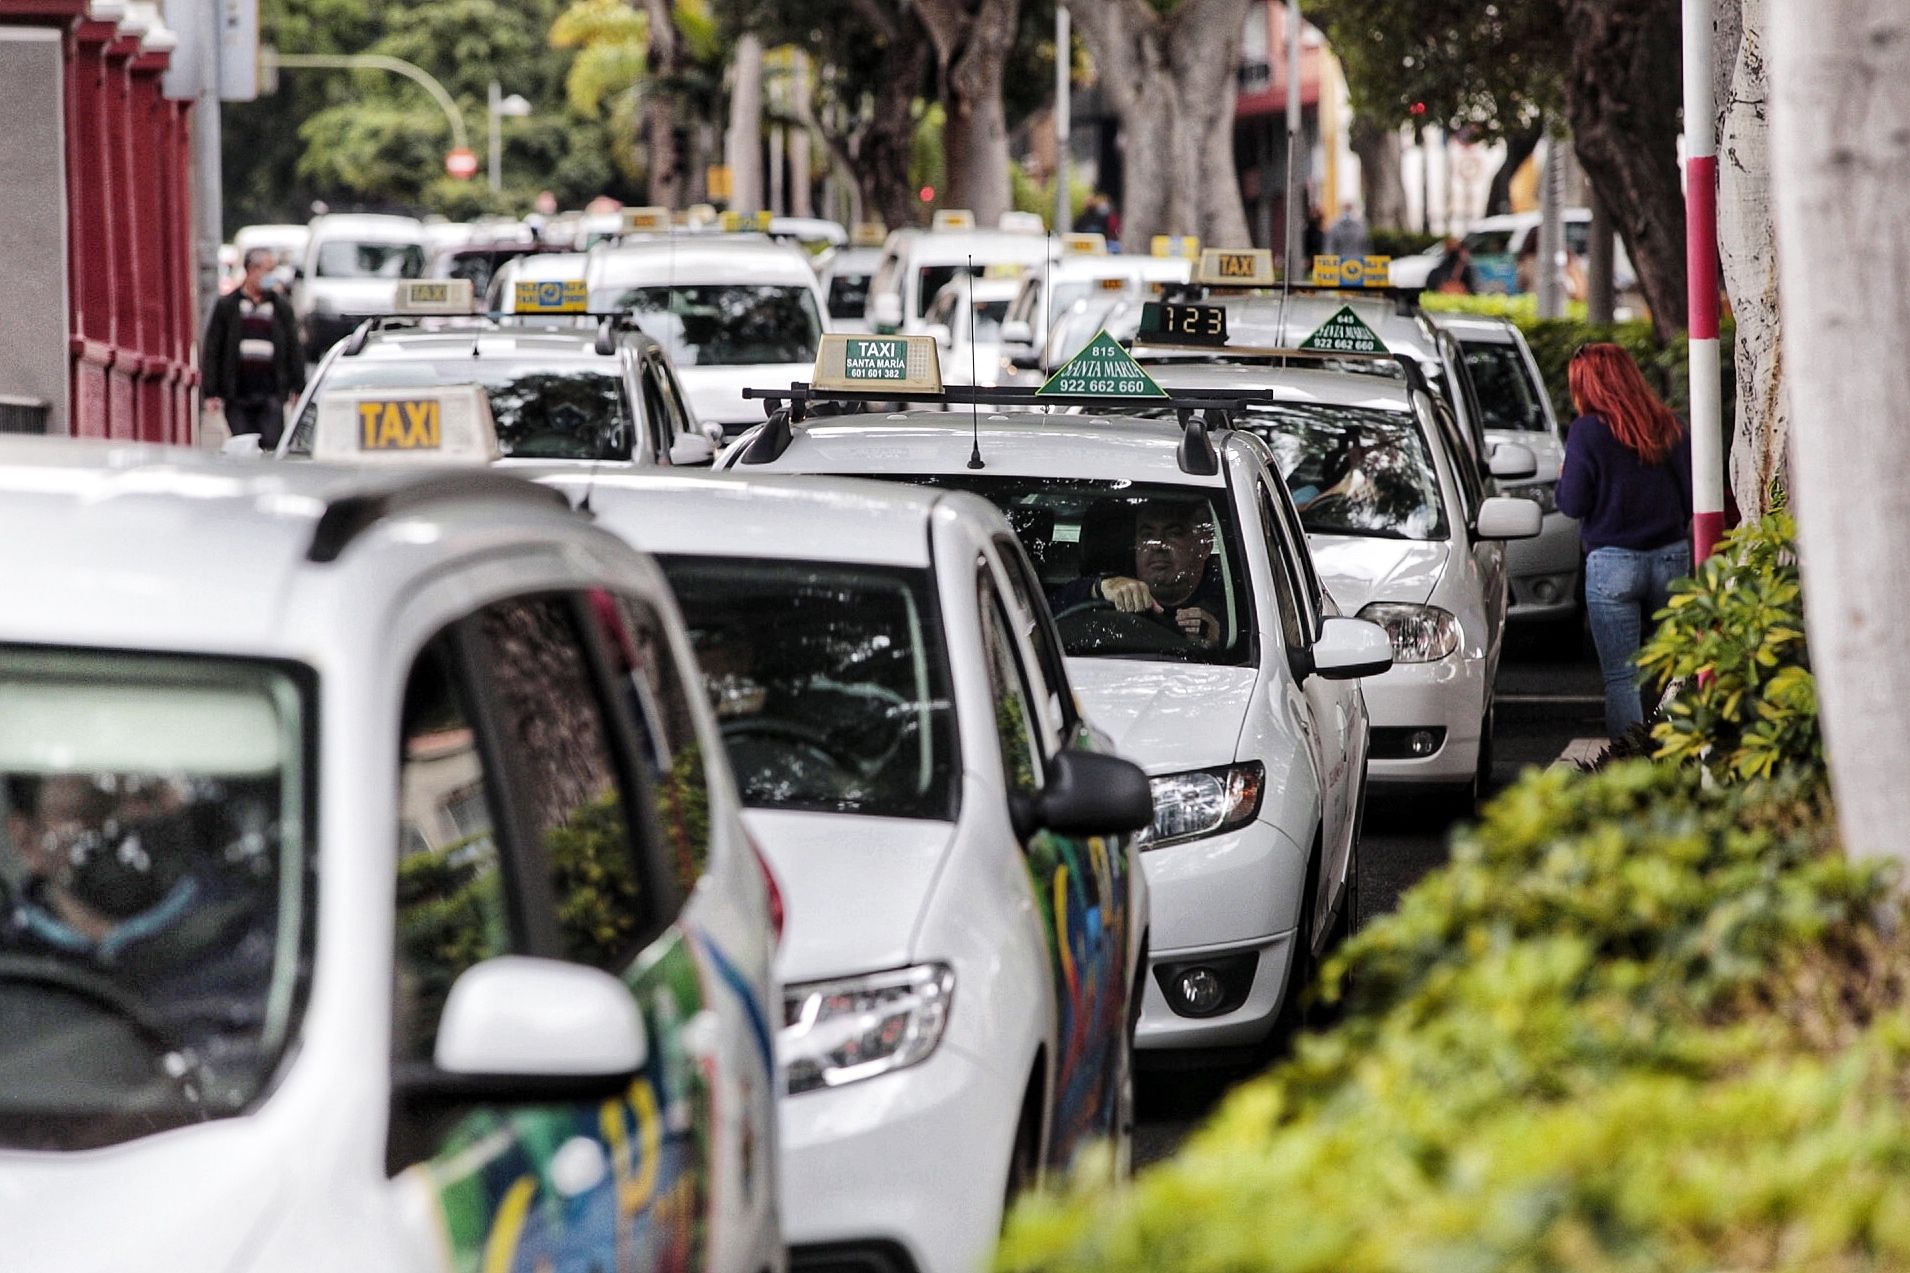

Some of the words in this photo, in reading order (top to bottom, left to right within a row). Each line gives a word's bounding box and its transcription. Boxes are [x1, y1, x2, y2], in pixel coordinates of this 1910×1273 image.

[1220, 255, 1254, 276] TAXI
[411, 285, 447, 302] TAXI
[1166, 307, 1222, 334] 123
[858, 342, 896, 357] TAXI
[1092, 346, 1115, 357] 815
[1313, 338, 1333, 348] 922
[1334, 339, 1354, 349] 662
[1355, 340, 1374, 351] 660
[846, 358, 875, 368] SANTA
[877, 358, 905, 368] MARÍA
[1060, 360, 1101, 377] SANTA
[1104, 360, 1146, 378] MARIA
[851, 368, 866, 378] 601
[868, 368, 882, 378] 601
[884, 369, 899, 378] 382
[1060, 379, 1085, 392] 922
[1089, 380, 1114, 392] 662
[1118, 380, 1144, 393] 660
[359, 402, 440, 449] TAXI
